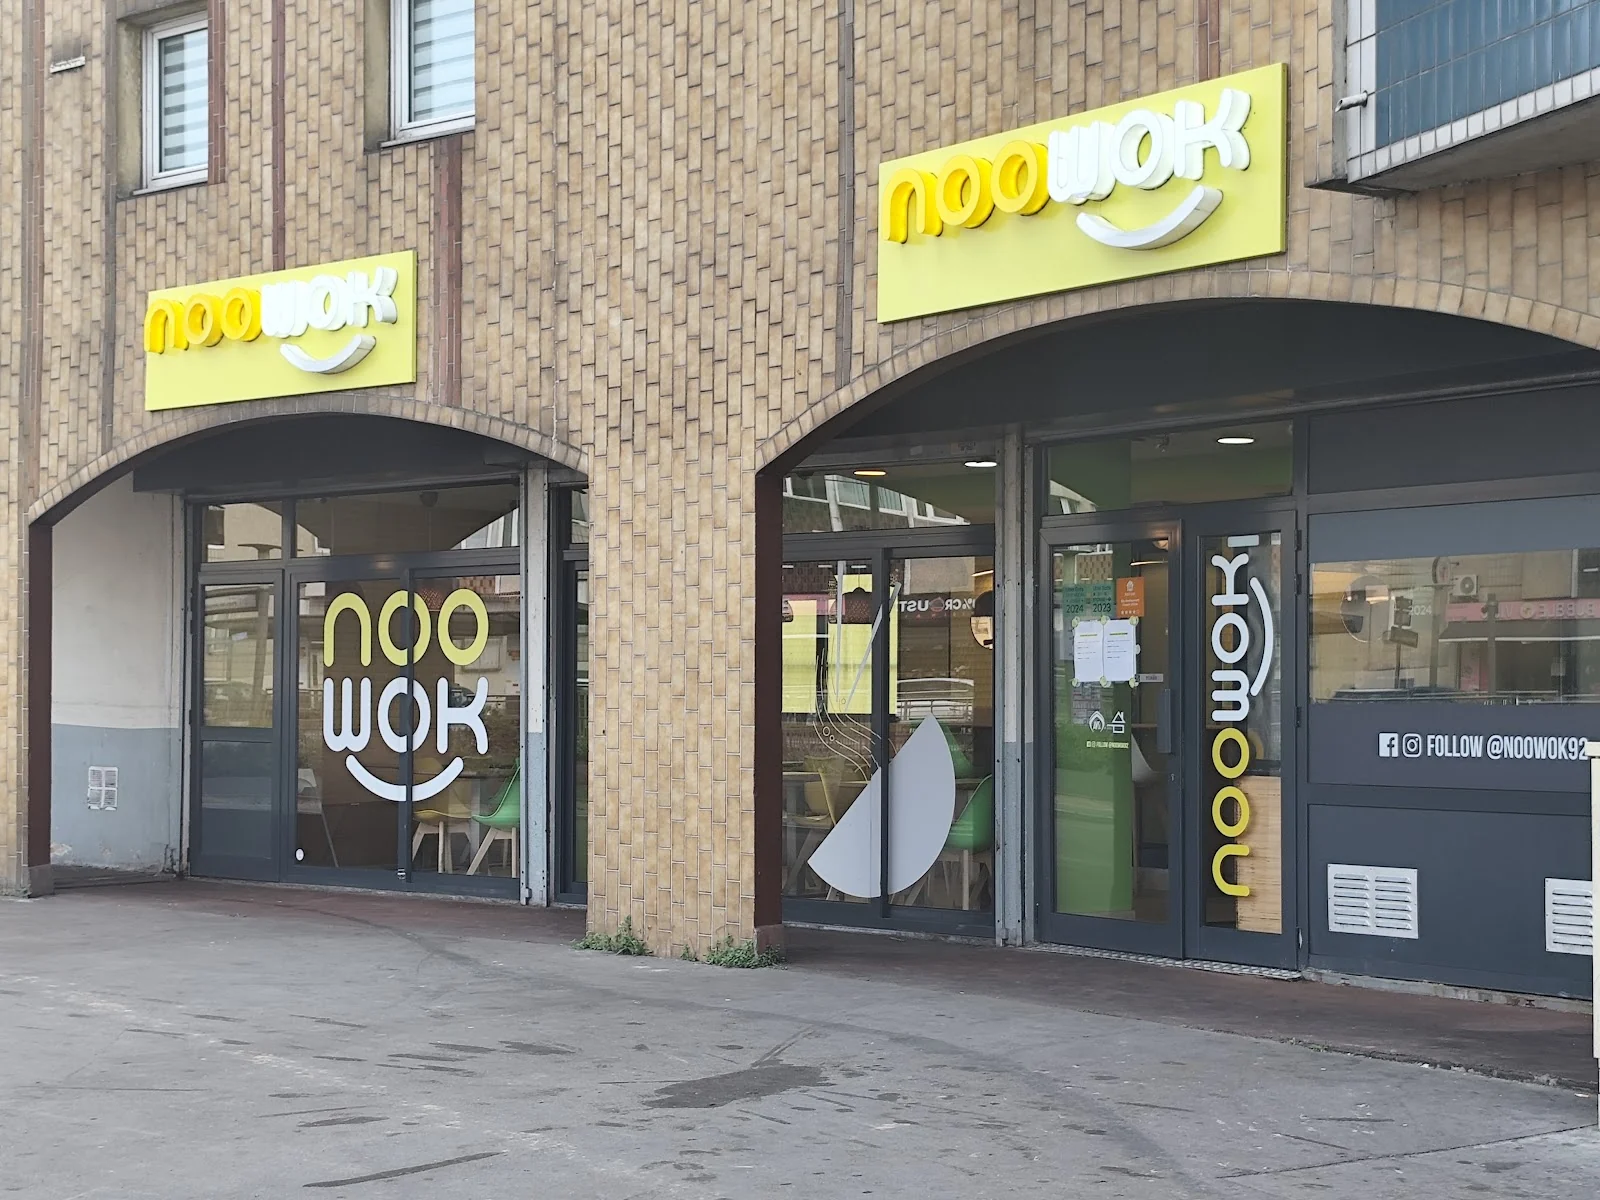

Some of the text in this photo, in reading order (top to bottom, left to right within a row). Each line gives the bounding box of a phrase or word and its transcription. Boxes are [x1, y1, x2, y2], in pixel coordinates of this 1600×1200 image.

[1066, 604, 1084, 613] 2024
[1092, 603, 1112, 613] 2023
[1426, 734, 1589, 760] FOLLOW @NOOWOK92
